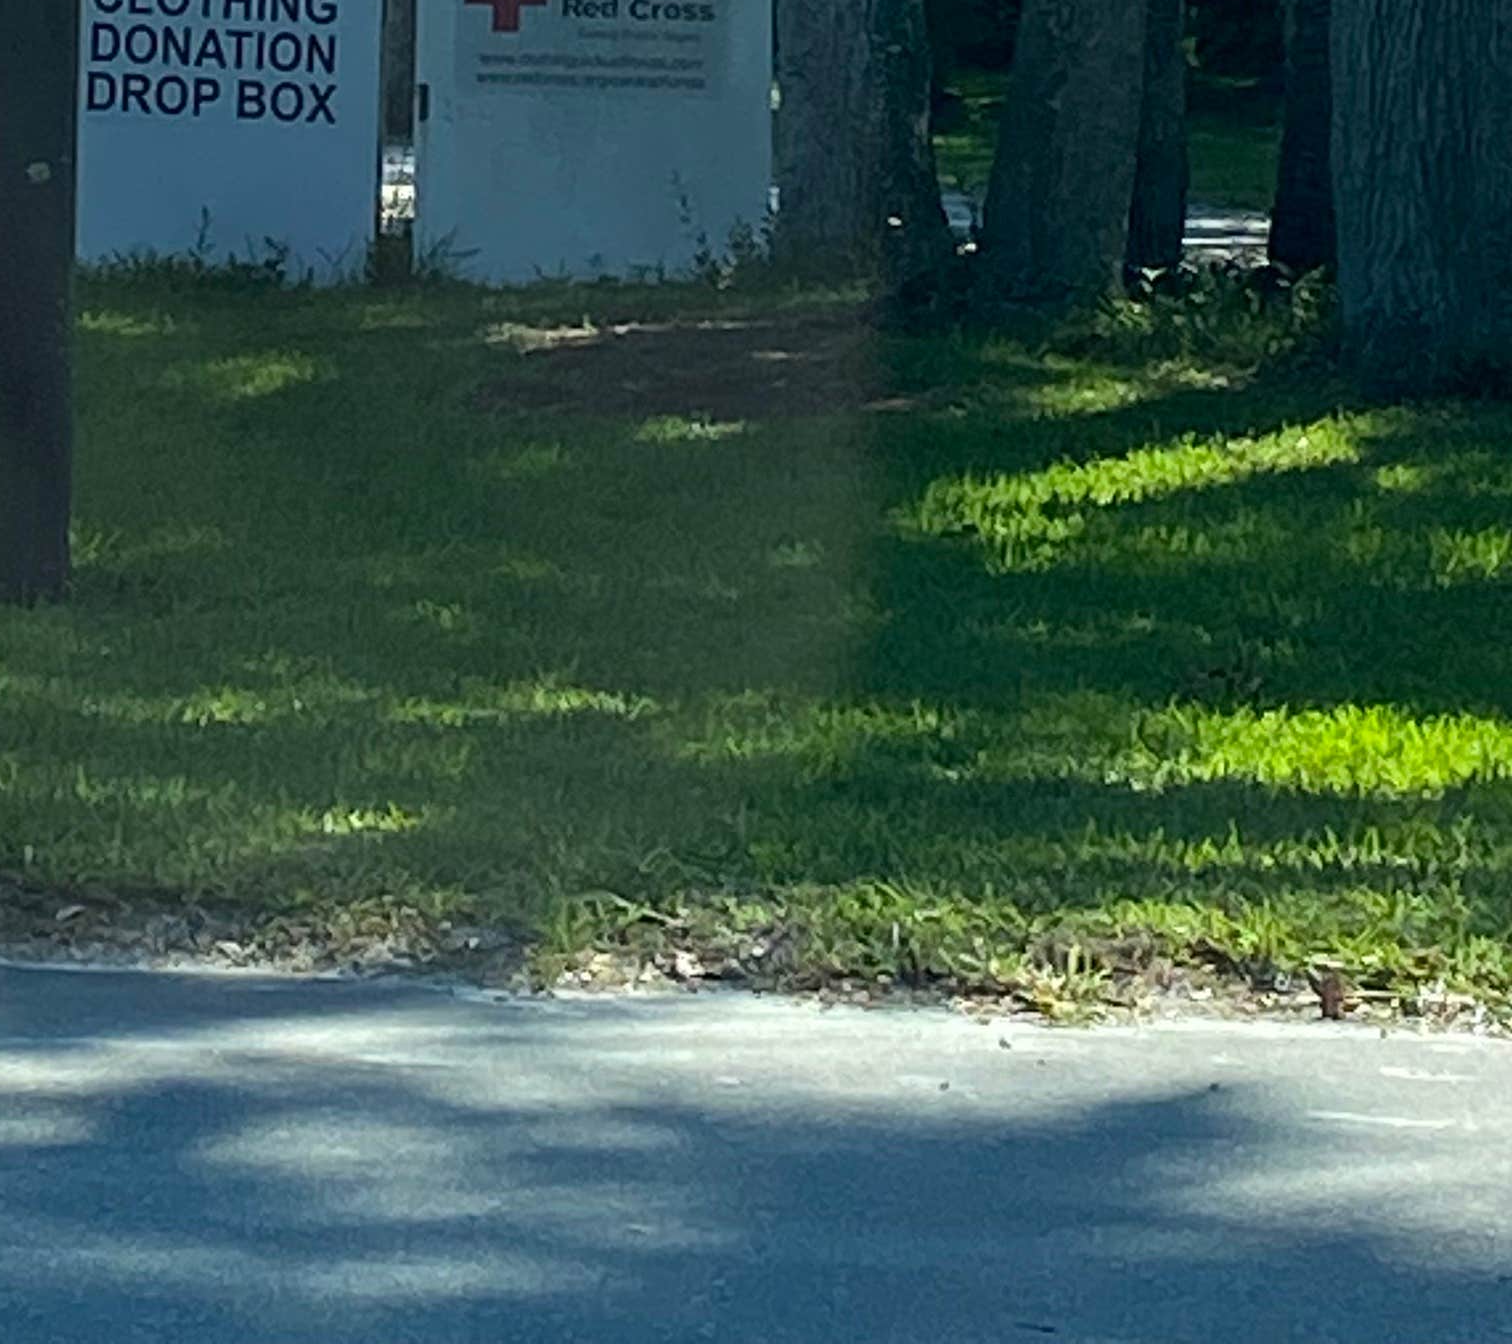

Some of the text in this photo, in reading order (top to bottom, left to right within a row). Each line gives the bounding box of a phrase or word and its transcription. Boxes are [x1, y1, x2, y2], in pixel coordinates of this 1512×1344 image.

[91, 21, 337, 75] DONATION
[87, 71, 338, 125] DROP BOX
